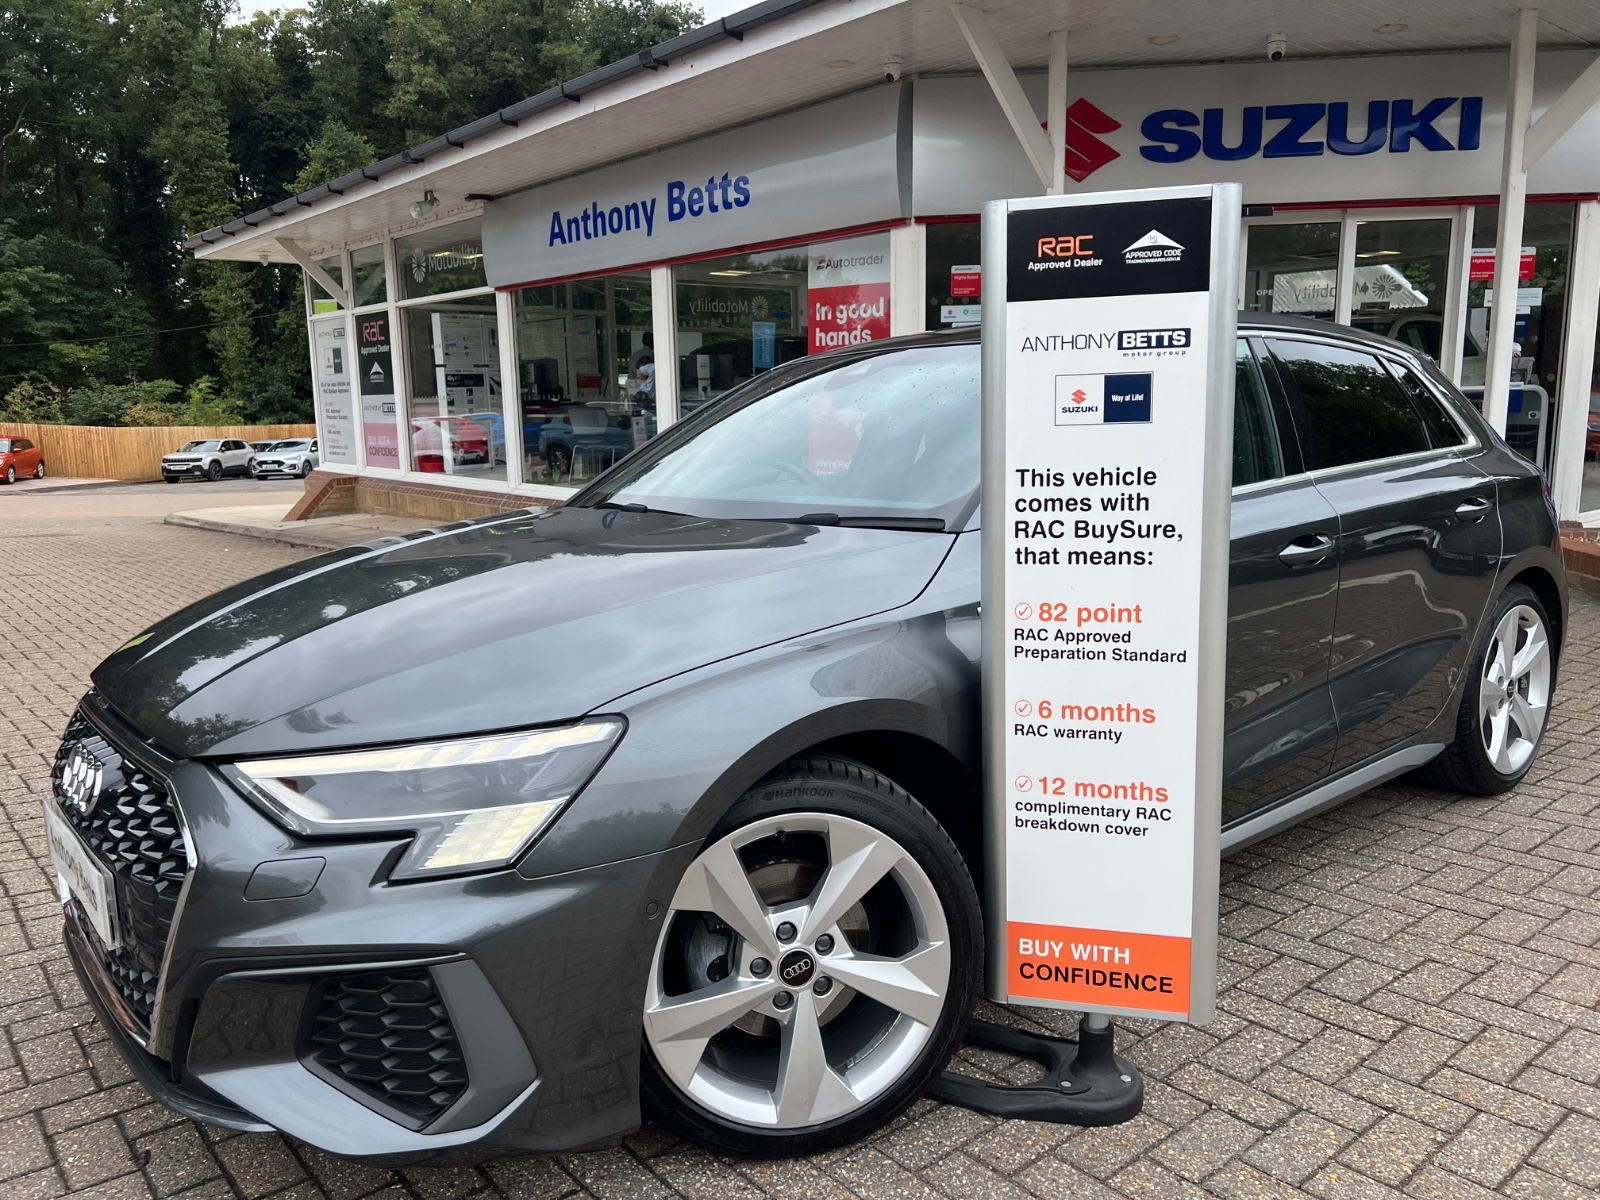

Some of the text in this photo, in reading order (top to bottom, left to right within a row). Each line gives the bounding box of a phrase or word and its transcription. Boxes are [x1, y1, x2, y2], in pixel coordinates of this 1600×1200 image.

[1139, 96, 1483, 163] SUZUKI
[549, 171, 750, 247] Anthony Betts
[428, 243, 479, 273] Motability
[825, 254, 884, 269] Autotrader
[1028, 257, 1103, 272] Approved Dealer
[1125, 249, 1182, 259] APPROVED CODE
[815, 296, 884, 324] In good
[815, 325, 872, 347] hands
[1021, 330, 1186, 352] ANTHONY BETTS
[1111, 394, 1124, 403] Way
[1132, 393, 1144, 401] Life!
[1061, 405, 1099, 413] SUZUKI
[1015, 466, 1157, 487] This vehicle
[1014, 492, 1150, 513] comes with
[1014, 519, 1183, 544] RAC BuySure,
[1014, 547, 1153, 565] that means:
[1038, 602, 1143, 628] 82 point
[1014, 628, 1131, 645] RAC Approved
[1014, 645, 1187, 663] Preparation Standard
[1038, 700, 1156, 724] 6 months
[1014, 724, 1122, 744] RAC warranty
[1038, 776, 1169, 803] 12 months
[1015, 801, 1172, 822] complimentary RAC
[1015, 816, 1149, 837] breakdown cover
[1018, 937, 1130, 965] BUY WITH
[1019, 962, 1174, 994] CONFIDENCE
